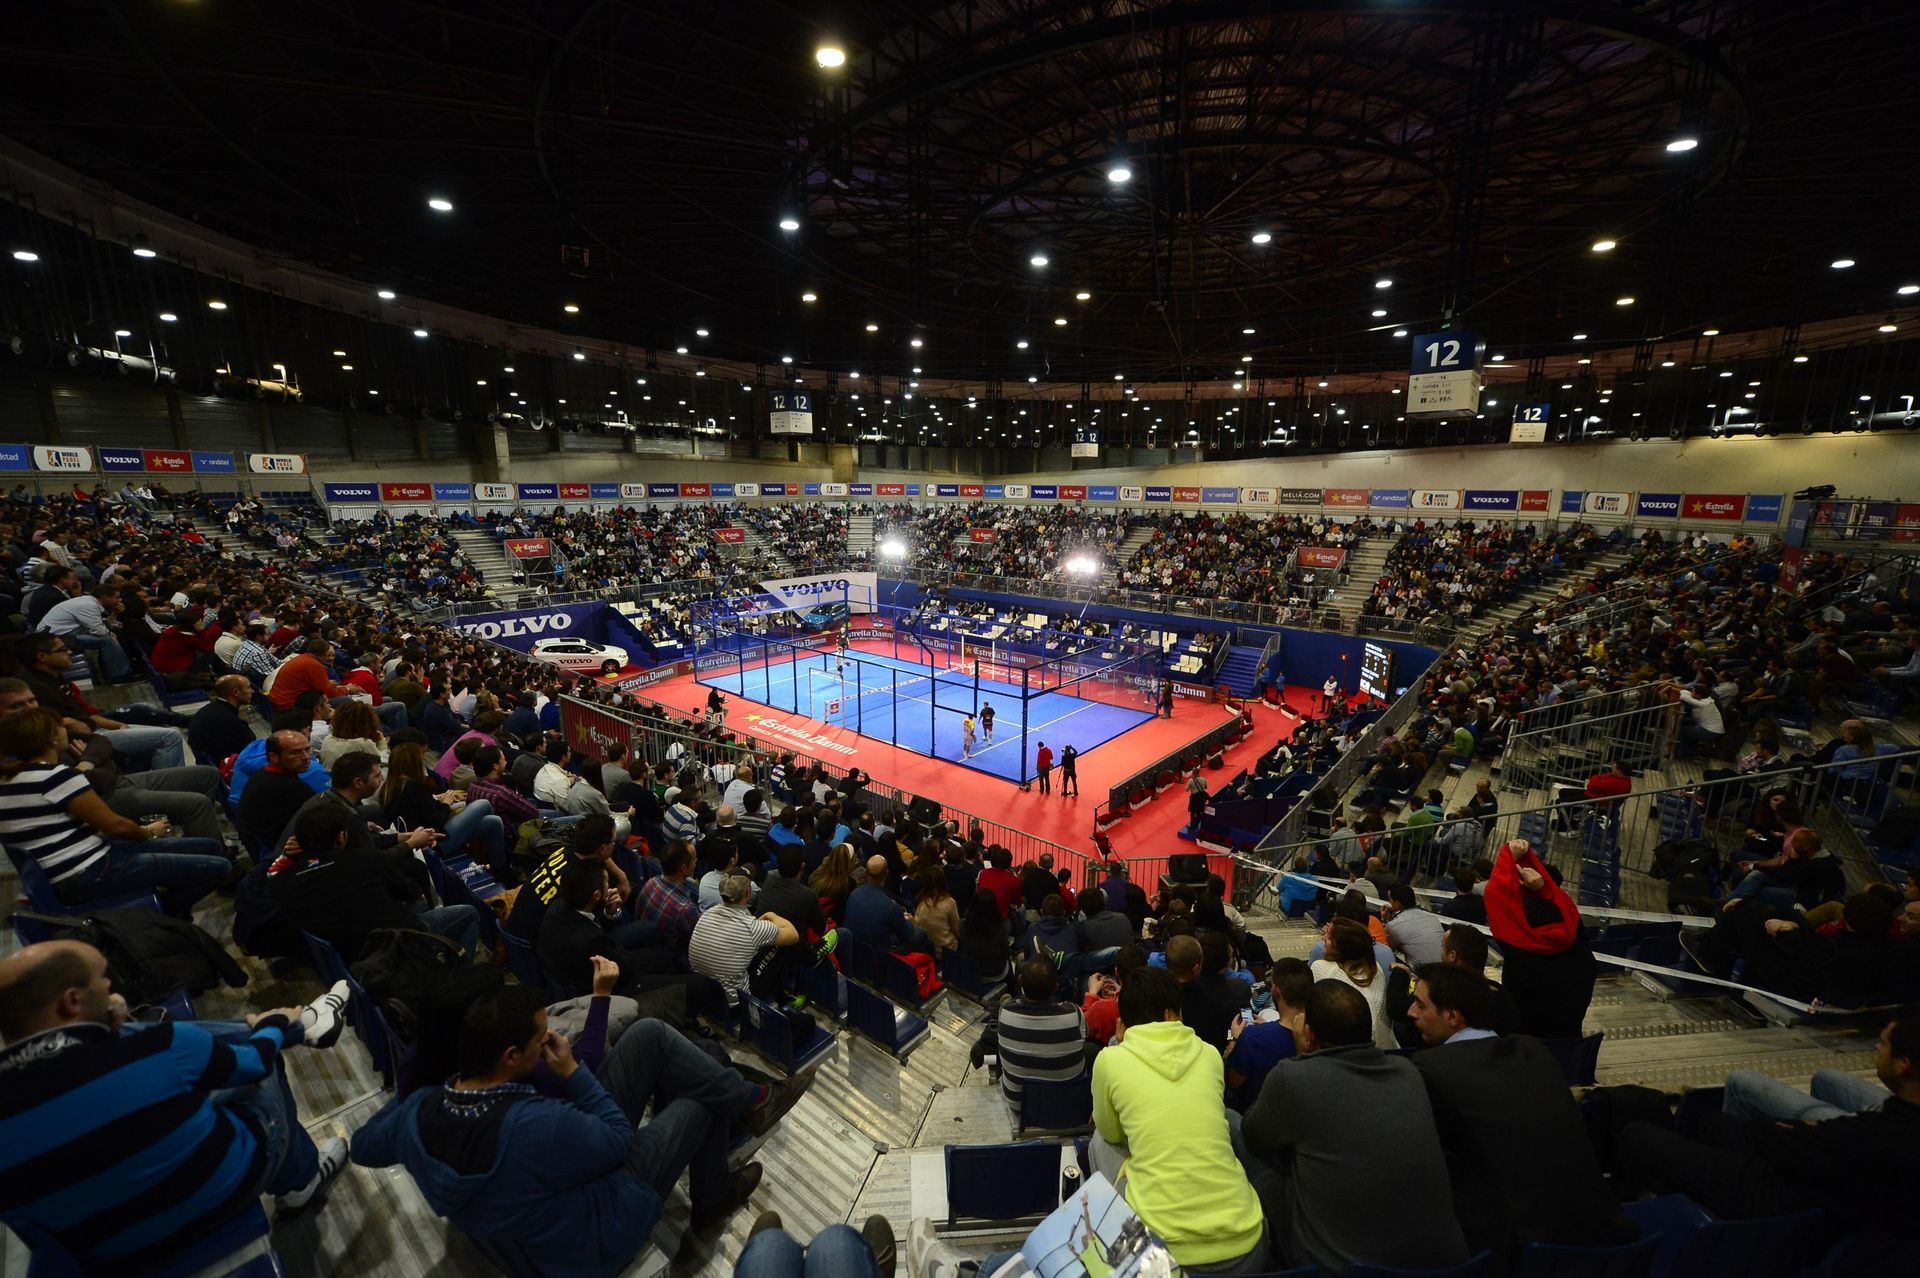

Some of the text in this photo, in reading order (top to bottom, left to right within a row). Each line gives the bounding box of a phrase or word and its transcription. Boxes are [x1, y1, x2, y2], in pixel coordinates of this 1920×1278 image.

[1426, 340, 1460, 367] 12
[774, 395, 785, 409] 12
[794, 395, 807, 410] 12
[1523, 407, 1542, 421] 12
[1075, 433, 1084, 442] 12
[1090, 432, 1097, 442] 12
[103, 456, 140, 464] VOLVO
[163, 456, 185, 465] Estrella
[1641, 501, 1677, 509] VOLVO
[1705, 502, 1734, 511] Estrella
[1316, 553, 1338, 561] Estrella
[780, 578, 850, 597] VOLVO
[453, 613, 572, 640] VOLVO
[849, 629, 871, 638] strella
[697, 655, 730, 667] Estrella
[1002, 651, 1026, 665] Dmm
[1048, 662, 1079, 674] Esrella
[619, 676, 650, 689] Estrella
[650, 666, 674, 681] Damm
[1172, 683, 1206, 698] Damm
[758, 718, 858, 756] Estrella Damm
[530, 862, 558, 905] TER
